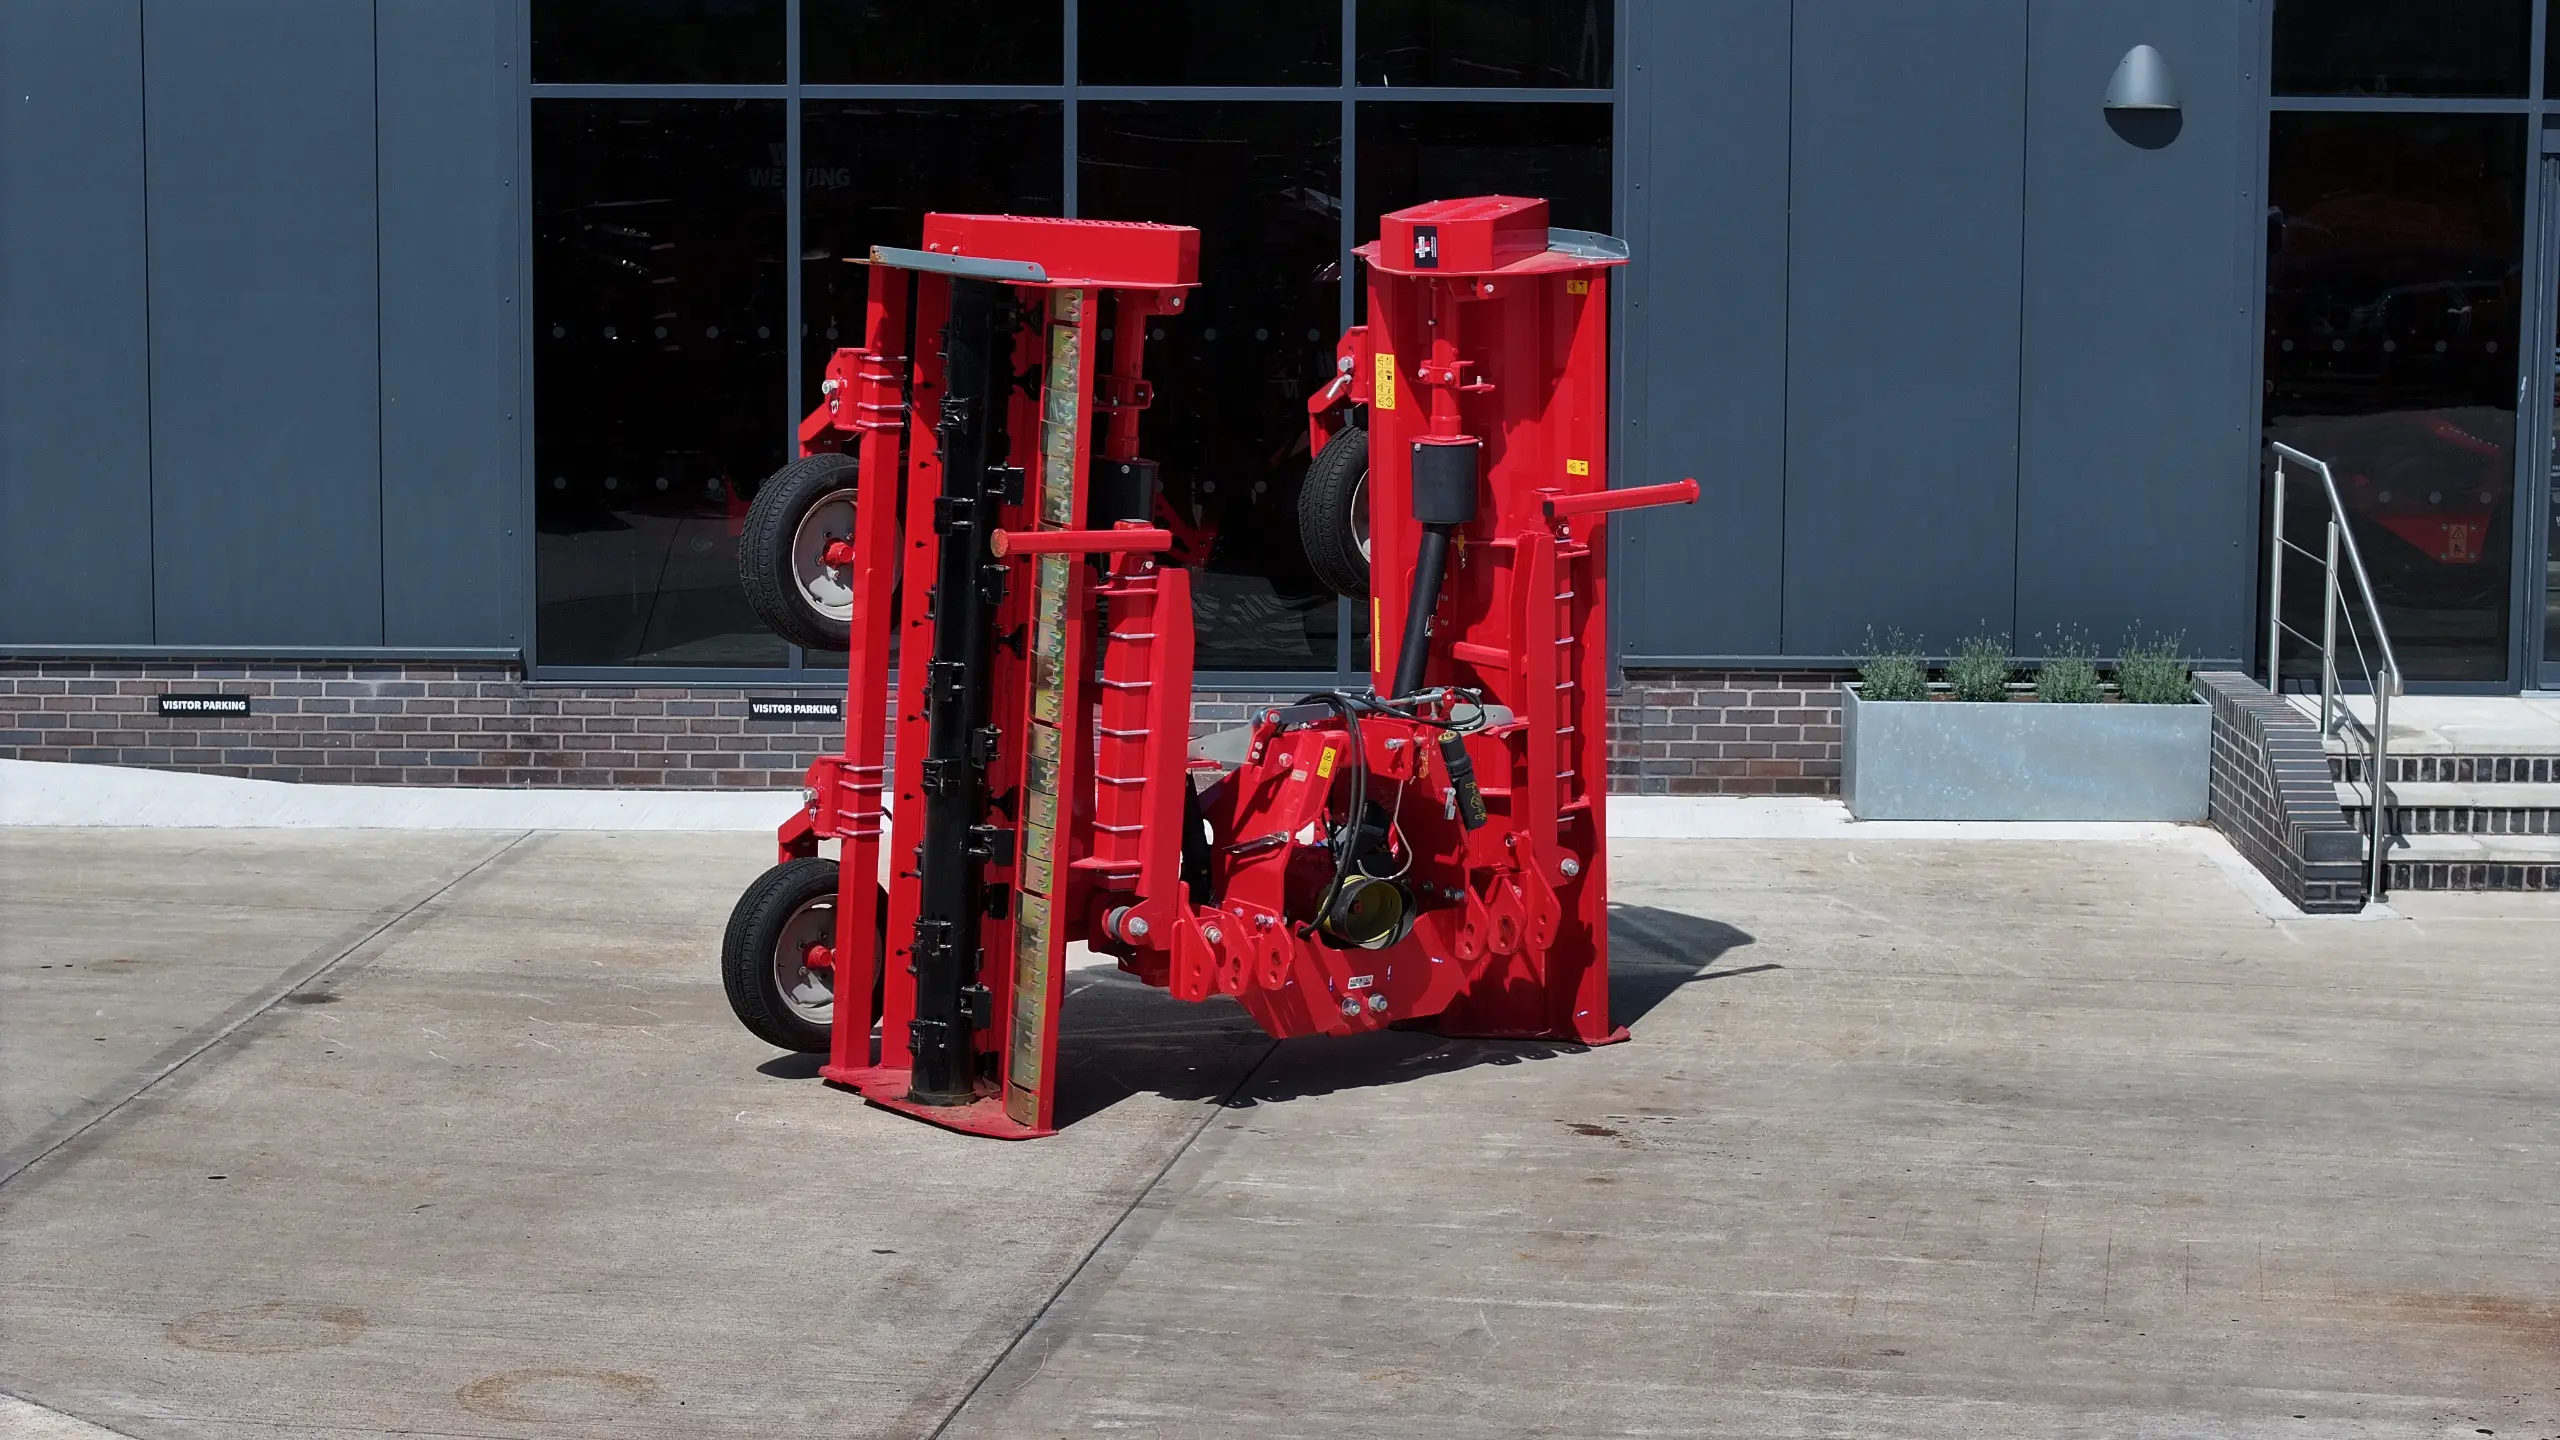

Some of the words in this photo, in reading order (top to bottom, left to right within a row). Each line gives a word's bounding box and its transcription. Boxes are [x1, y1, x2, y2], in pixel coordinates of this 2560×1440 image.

[162, 700, 202, 710] VISITOR
[202, 701, 246, 711] PARKING
[752, 703, 793, 714] VISITOR
[793, 704, 838, 715] PARKING
